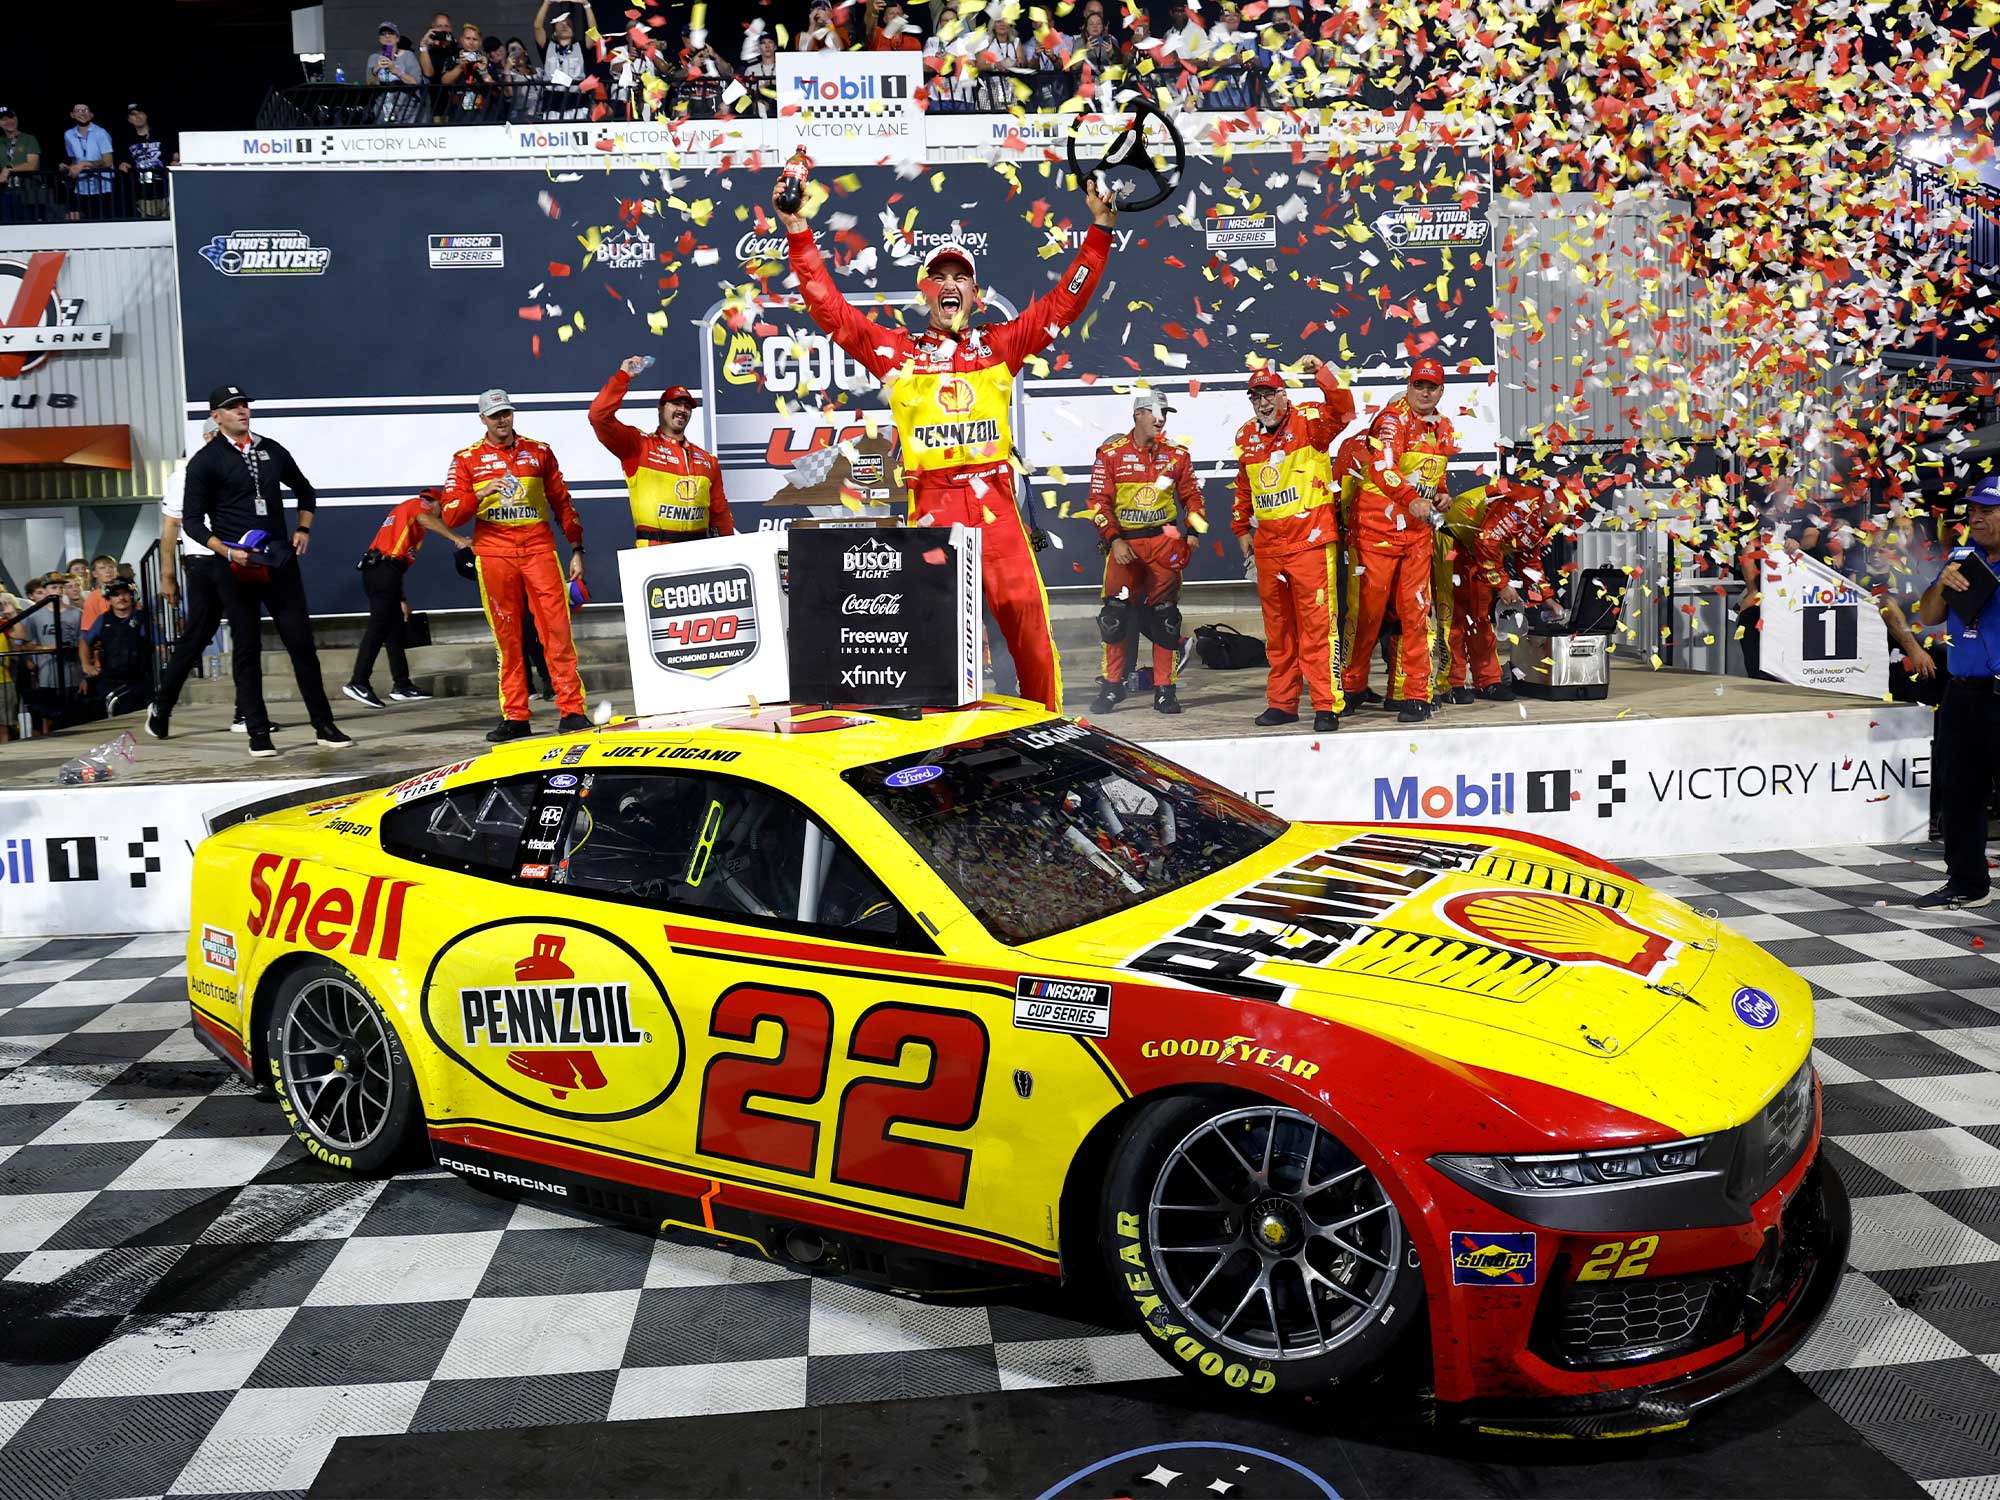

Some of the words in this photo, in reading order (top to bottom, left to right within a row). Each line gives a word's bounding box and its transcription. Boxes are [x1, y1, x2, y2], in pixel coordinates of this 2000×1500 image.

[794, 75, 875, 100] Mobil
[796, 123, 863, 137] VICTORY
[868, 122, 909, 136] LANE
[243, 138, 292, 154] Mobil
[340, 138, 404, 151] VICTORY
[408, 137, 447, 150] LANE
[520, 131, 569, 148] Mobil
[1228, 218, 1265, 229] NASCAR
[1436, 211, 1468, 223] YOUR
[913, 229, 987, 248] Freeway
[1216, 232, 1235, 243] CUP
[1234, 231, 1266, 242] SERIES
[1408, 222, 1487, 241] DRIVER?
[226, 238, 269, 250] WHO'S
[271, 237, 307, 250] YOUR
[451, 237, 493, 247] NASCAR
[241, 250, 328, 269] DRIVER?
[439, 251, 459, 261] CUP
[459, 250, 493, 261] SERIES
[595, 241, 656, 263] BUSCH
[608, 260, 644, 269] LIGHT
[35, 332, 105, 344] LANE
[0, 393, 78, 410] UB
[914, 418, 1001, 448] PENNZOIL
[843, 551, 903, 572] BUSCH
[853, 569, 890, 579] LIGHT
[965, 535, 974, 616] SERIES
[667, 614, 739, 646] 400
[841, 628, 909, 648] Freeway
[841, 647, 908, 655] INSURANCE
[966, 618, 974, 665] CUP
[667, 653, 709, 665] RICHMOND
[709, 648, 746, 660] RACEWAY
[841, 665, 908, 689] xfinity
[1817, 676, 1845, 684] NASCAR
[1825, 667, 1844, 675] Motor
[1016, 724, 1092, 750] LOGANO
[601, 746, 658, 758] JOEY
[656, 748, 742, 763] LOGANO
[385, 758, 476, 797] DISCOUNT
[553, 776, 573, 785] Ford
[896, 768, 935, 785] Ford
[402, 780, 440, 800] TIRE
[1373, 771, 1515, 821] Mobil
[1648, 760, 1819, 802] VICTORY
[1830, 754, 1932, 794] LANE
[325, 817, 373, 838] Snap-on
[527, 838, 556, 850] Mazak
[246, 852, 424, 961] Shell
[1126, 834, 1496, 1002] PENNZOIL
[191, 975, 238, 1006] Autotrader
[1045, 982, 1097, 1003] NASCAR
[461, 984, 642, 1045] PENNZOIL
[1026, 1003, 1052, 1018] CUP
[1051, 1006, 1097, 1024] SERIES
[1737, 993, 1773, 1025] Ford
[695, 981, 991, 1210] 22
[438, 1156, 491, 1179] FORD
[492, 1170, 568, 1197] RACING
[1456, 1250, 1532, 1269] SUNOCO
[1575, 1234, 1661, 1283] 22
[1116, 1210, 1277, 1395] GOODYEAR
